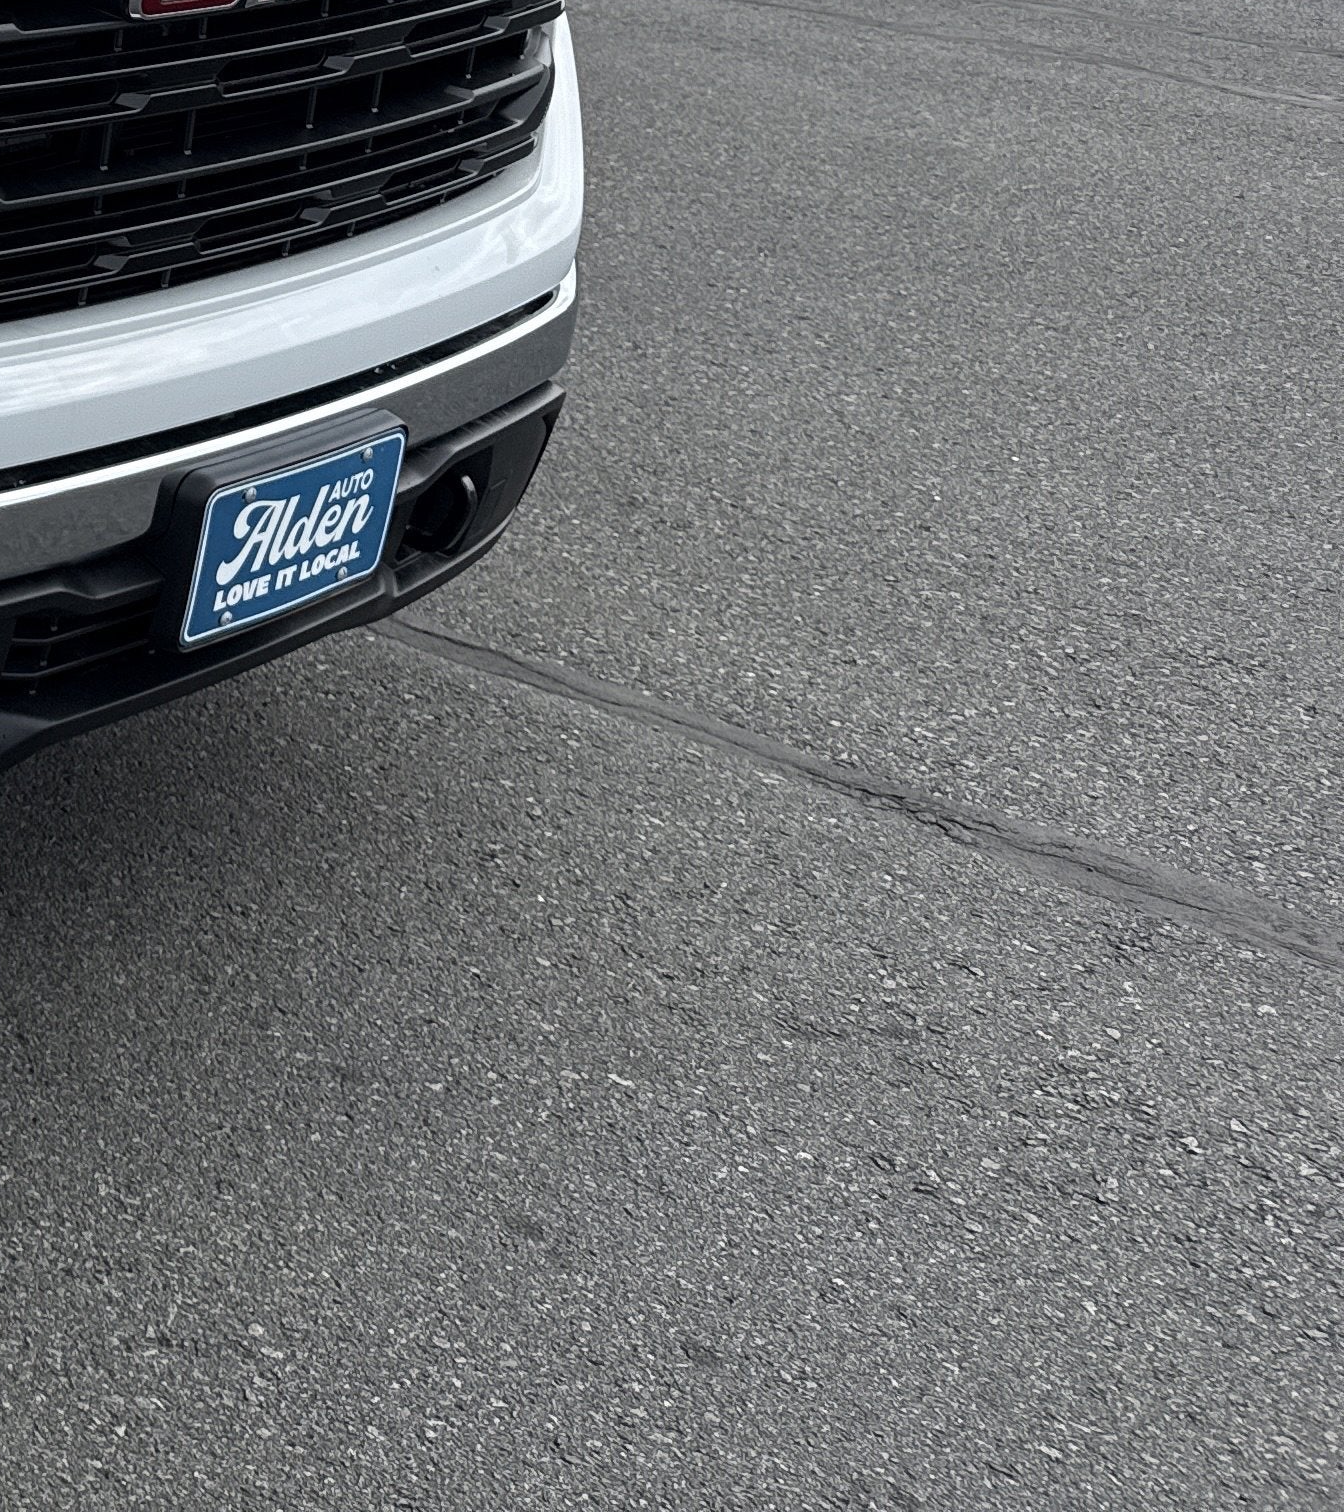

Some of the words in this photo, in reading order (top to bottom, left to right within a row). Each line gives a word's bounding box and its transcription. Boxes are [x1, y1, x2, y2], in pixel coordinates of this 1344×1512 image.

[328, 468, 374, 503] AUTO
[216, 484, 374, 586] Alden
[213, 574, 272, 612] LOVE
[275, 564, 298, 590] IT
[298, 540, 361, 582] LOCAL
